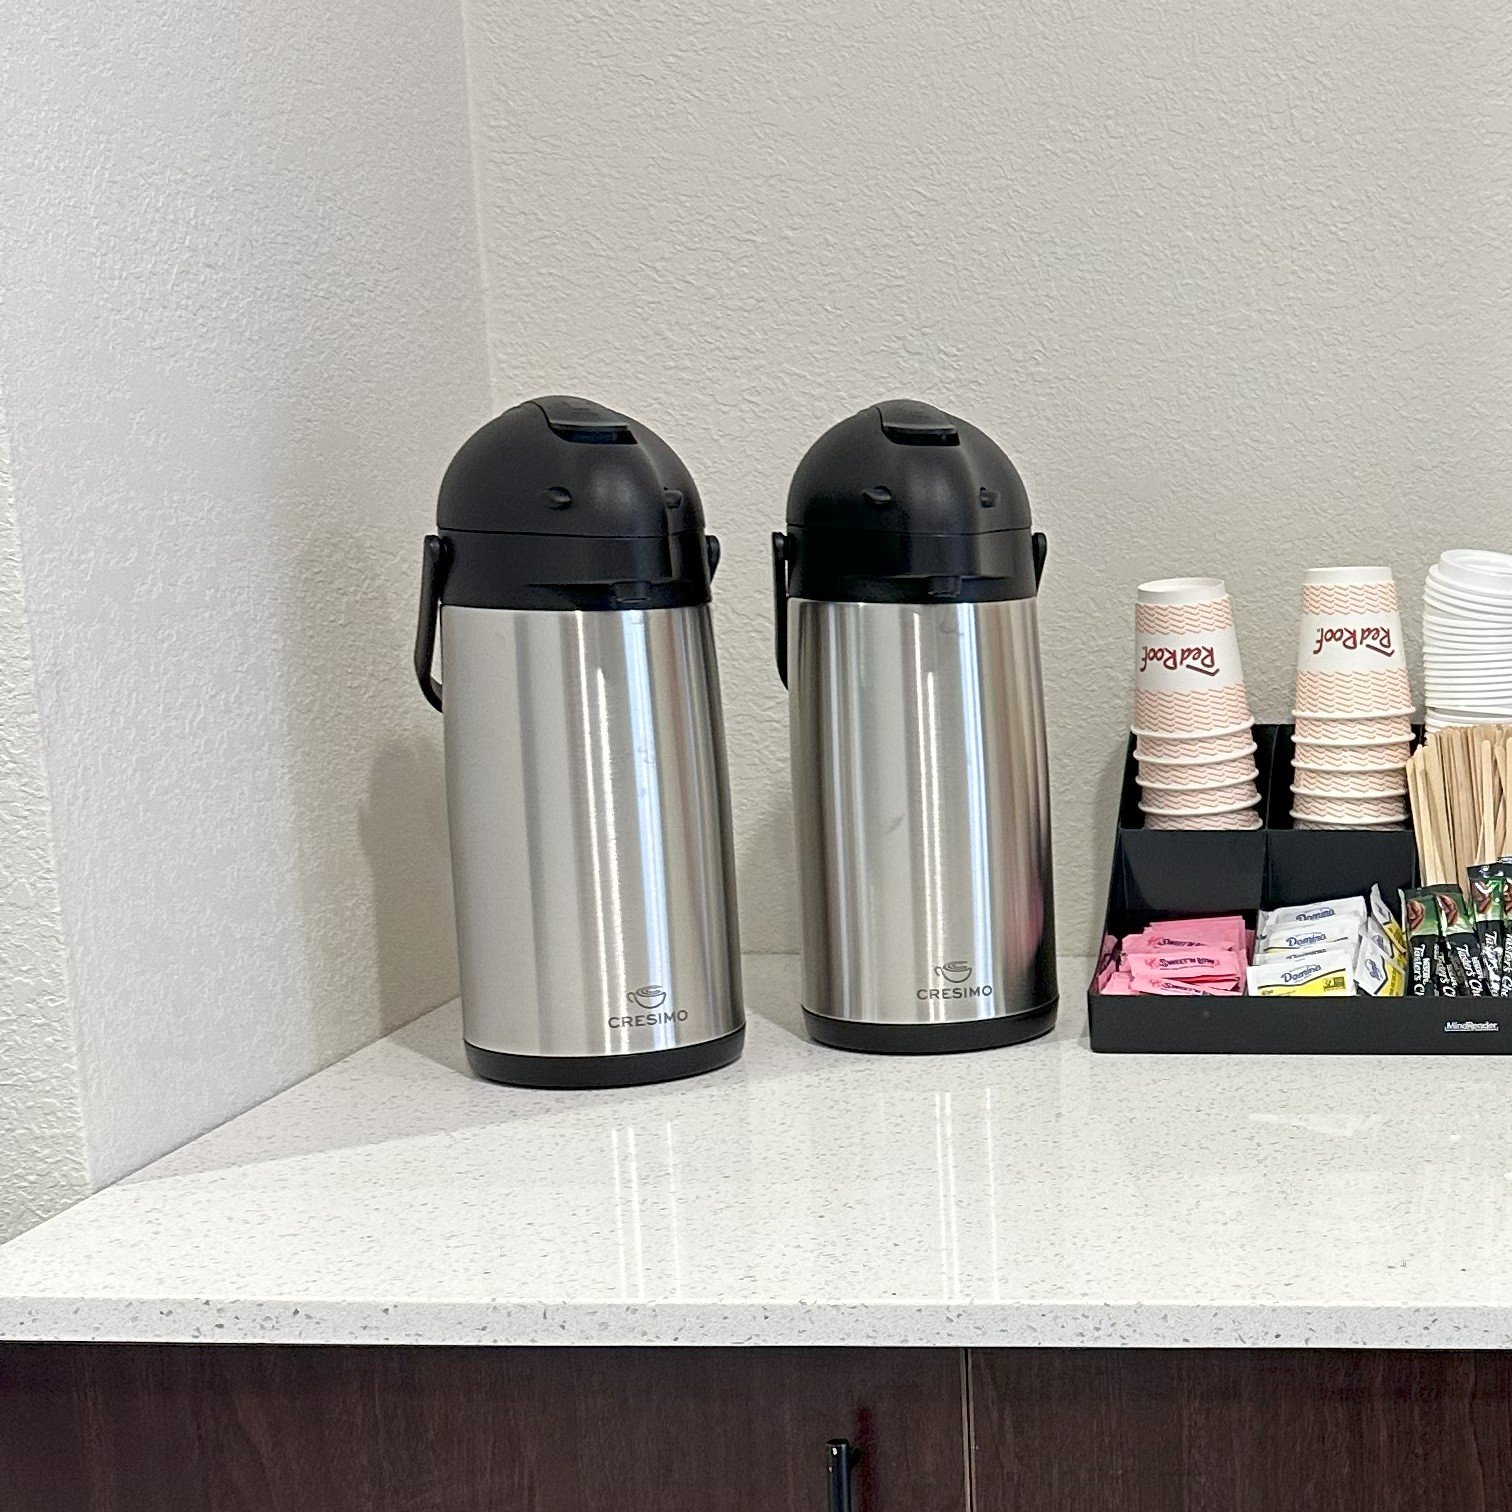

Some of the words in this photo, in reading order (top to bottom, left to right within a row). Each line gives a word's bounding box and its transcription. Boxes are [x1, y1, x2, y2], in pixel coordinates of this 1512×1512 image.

[1285, 932, 1327, 947] Domino
[1280, 963, 1323, 983] Domino
[916, 984, 993, 1000] CRESIMO
[608, 1009, 688, 1029] CRESIMO
